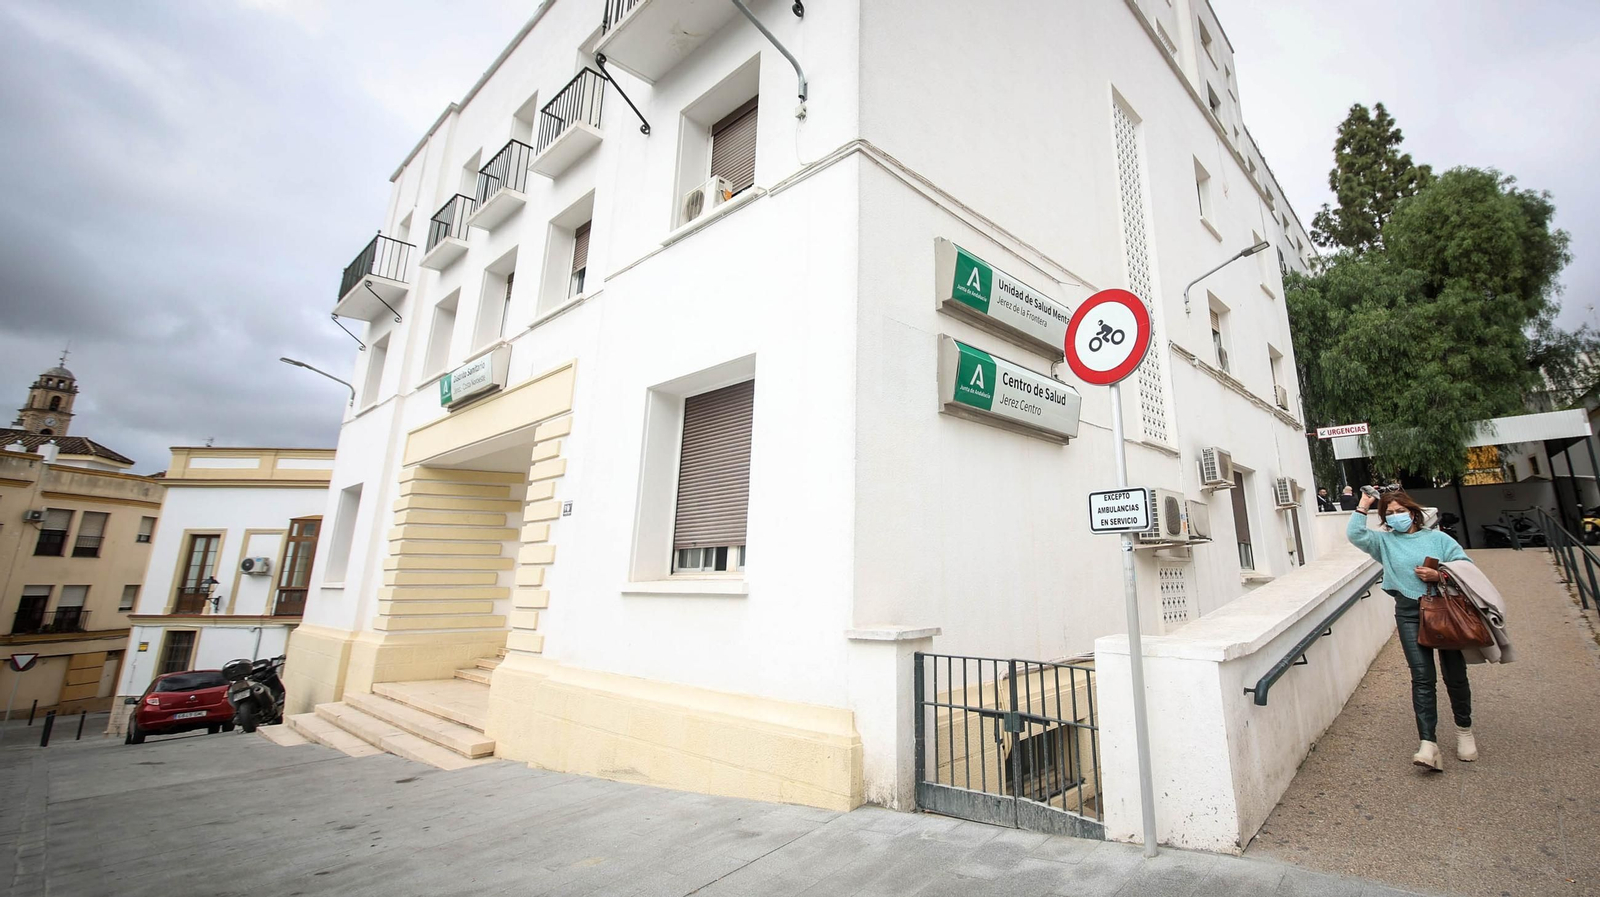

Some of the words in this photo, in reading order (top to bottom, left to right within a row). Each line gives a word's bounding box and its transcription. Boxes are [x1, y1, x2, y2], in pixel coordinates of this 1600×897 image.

[957, 284, 967, 293] Junta
[999, 279, 1024, 301] Unidad
[1024, 291, 1033, 305] de
[1034, 298, 1051, 315] Salud
[1053, 309, 1070, 325] Menta
[997, 296, 1012, 311] Jerez
[1012, 302, 1020, 313] de
[1020, 305, 1026, 316] la
[1026, 310, 1047, 327] Frontera
[960, 385, 970, 393] Junta
[1003, 373, 1032, 393] Centro
[1033, 383, 1044, 396] de
[1045, 388, 1066, 406] Salud
[1000, 394, 1018, 409] Jerez
[1020, 399, 1041, 415] Centro
[1327, 426, 1366, 435] URGENCIAS
[1104, 492, 1130, 501] EXCEPTO
[1098, 504, 1139, 514] AMBULANCIAS
[1101, 518, 1109, 526] EN
[1110, 517, 1138, 526] SERVICIO
